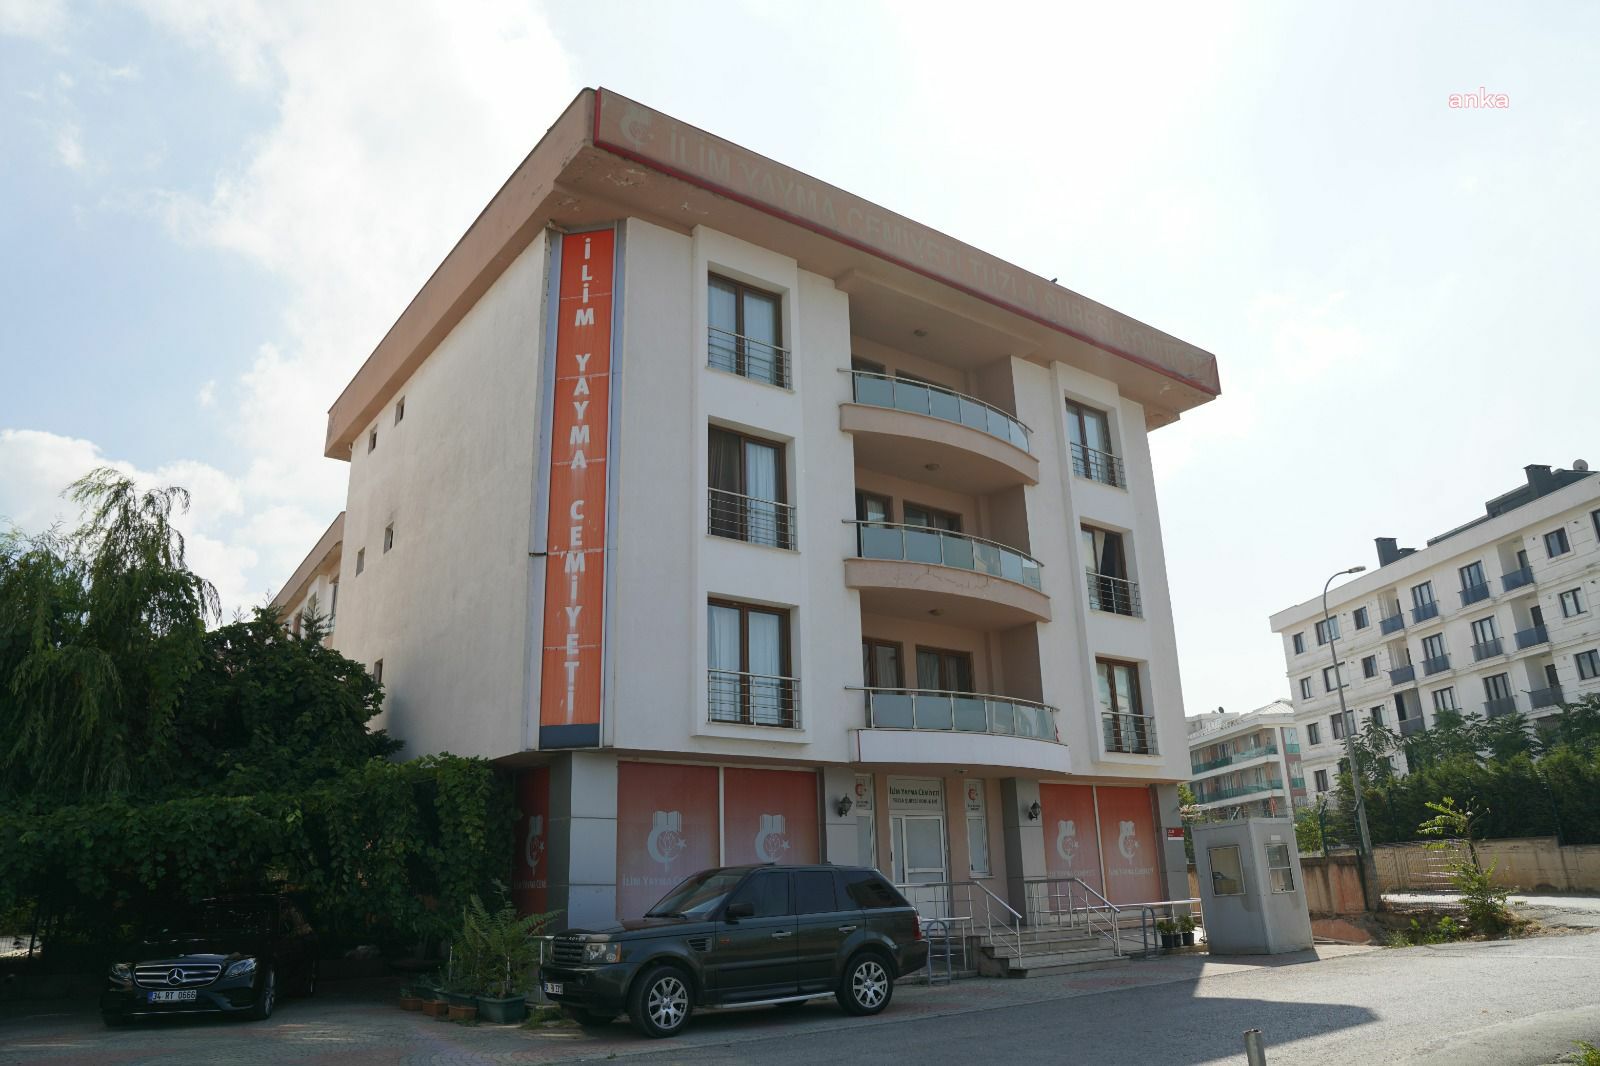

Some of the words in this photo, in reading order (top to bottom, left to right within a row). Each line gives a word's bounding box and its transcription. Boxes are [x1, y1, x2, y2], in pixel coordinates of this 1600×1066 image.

[669, 123, 731, 182] İLİM
[738, 161, 840, 230] YAYMA
[574, 237, 595, 327] İLİM
[569, 353, 591, 470] YAYMA
[564, 499, 586, 725] CEMİYETİ
[152, 991, 161, 1000] 34
[165, 991, 174, 1000] RT
